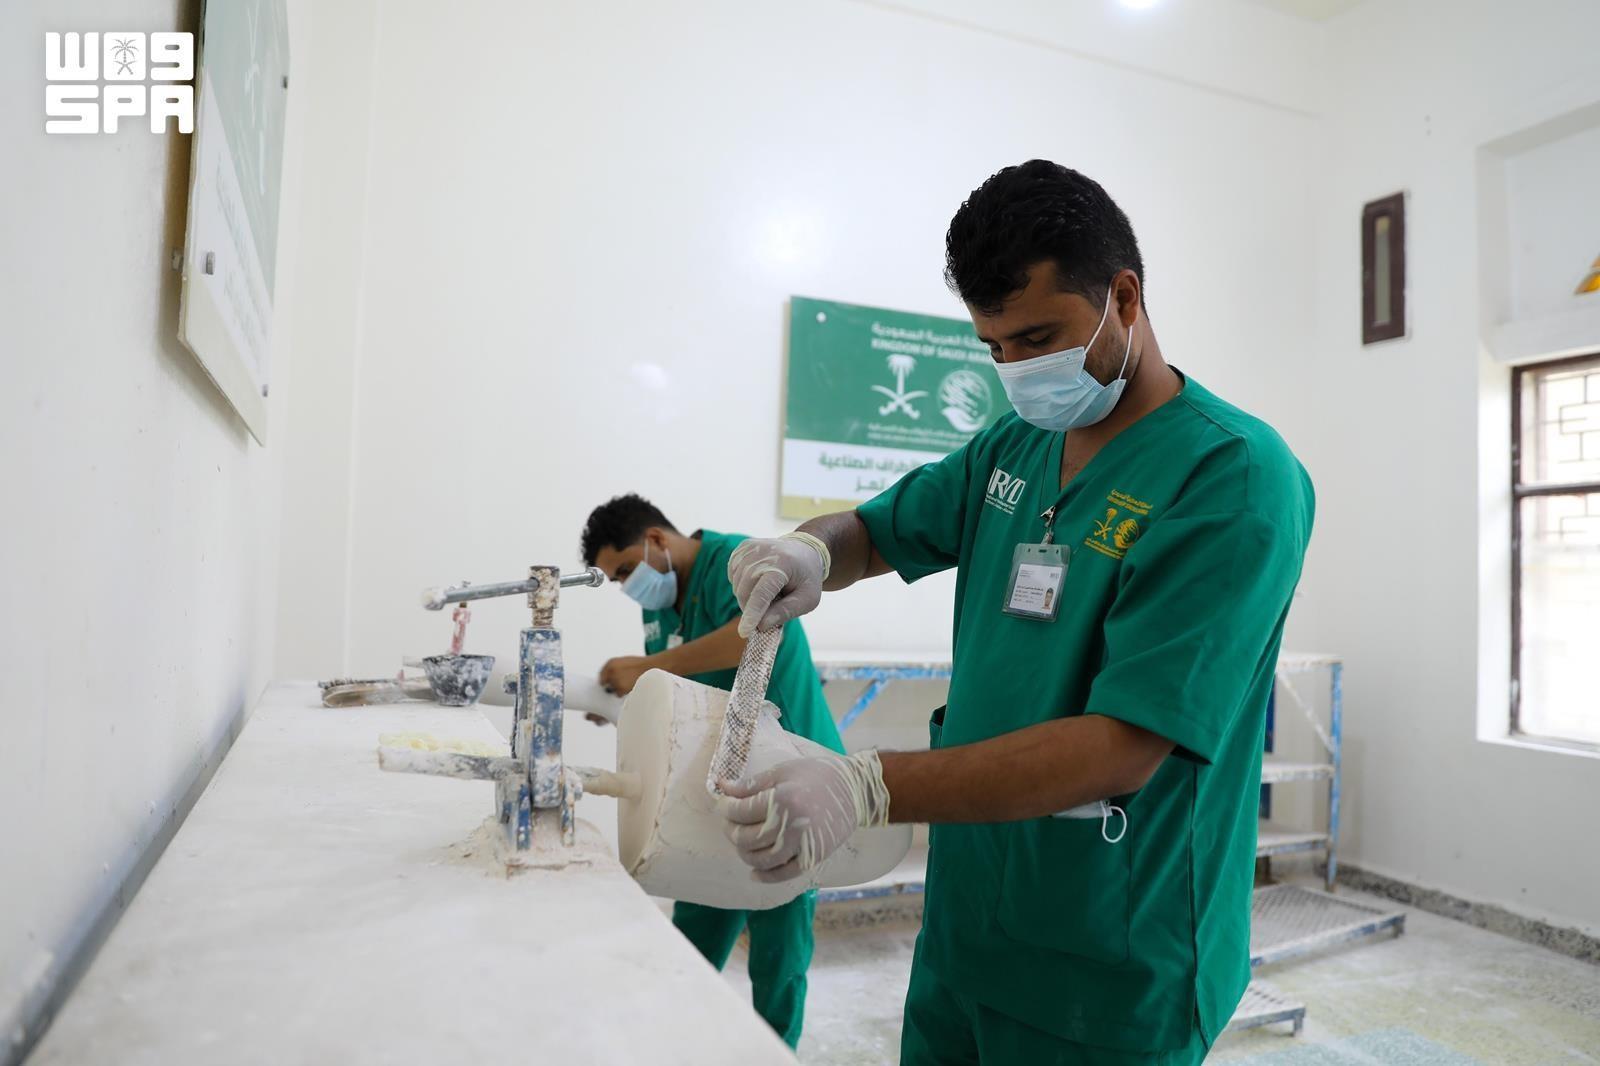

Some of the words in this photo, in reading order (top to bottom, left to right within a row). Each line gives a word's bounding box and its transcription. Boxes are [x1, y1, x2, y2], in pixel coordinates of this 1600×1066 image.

[871, 338, 920, 355] KINGDOM
[921, 345, 936, 357] OF
[937, 347, 966, 361] SAUDI
